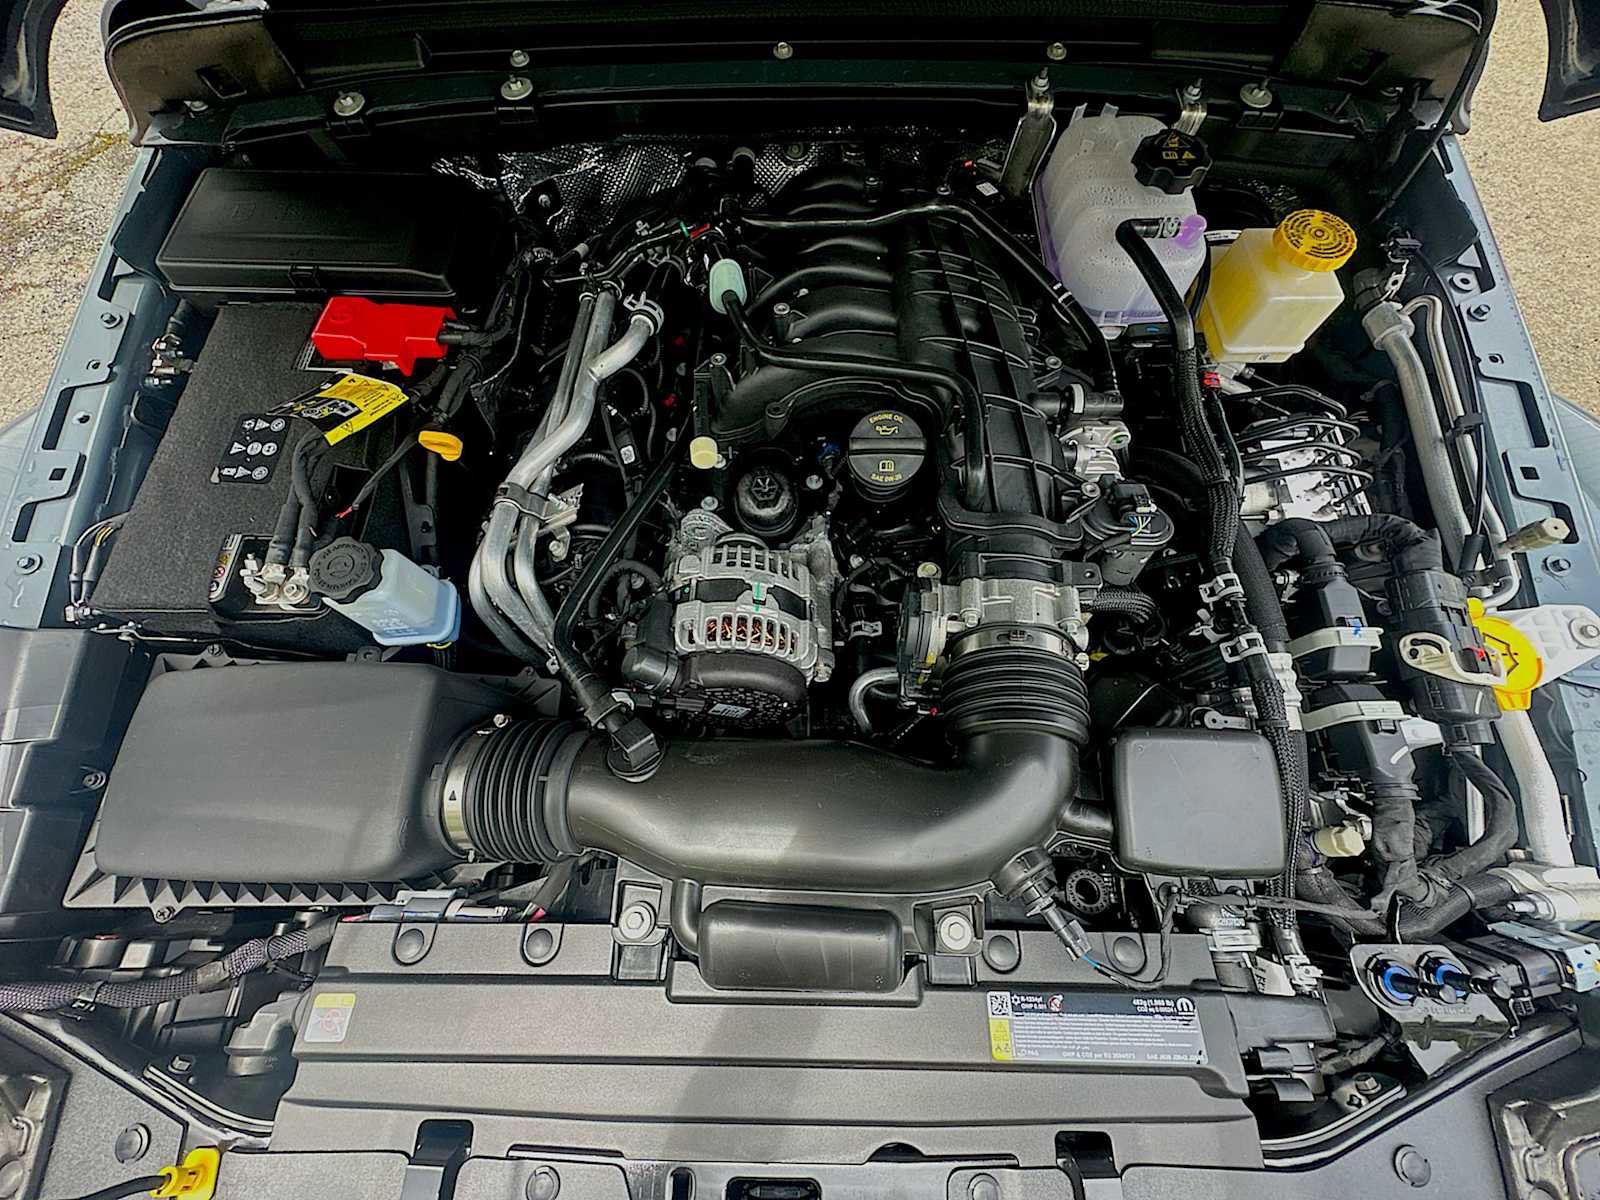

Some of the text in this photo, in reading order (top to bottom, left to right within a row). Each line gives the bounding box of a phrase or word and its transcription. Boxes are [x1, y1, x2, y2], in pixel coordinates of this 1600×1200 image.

[869, 412, 904, 424] ENGINE OIL
[870, 473, 884, 482] SAE
